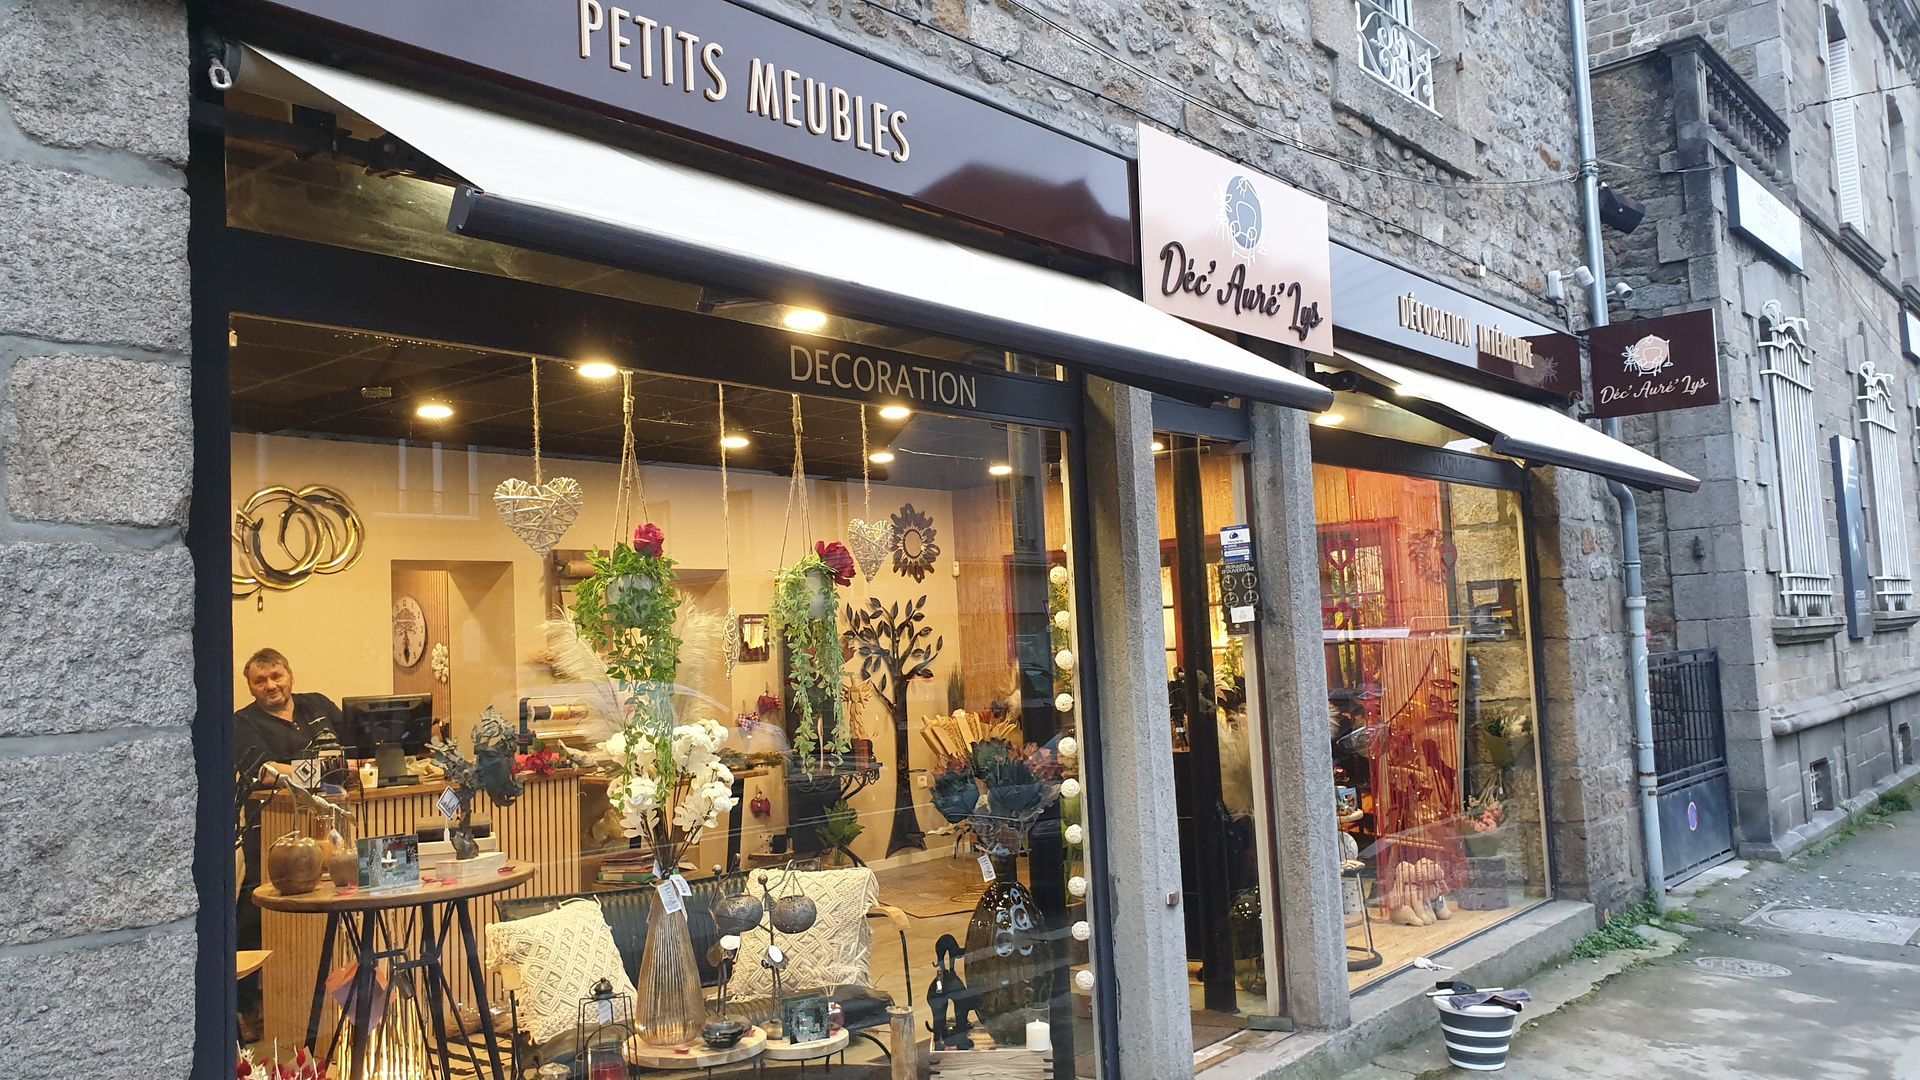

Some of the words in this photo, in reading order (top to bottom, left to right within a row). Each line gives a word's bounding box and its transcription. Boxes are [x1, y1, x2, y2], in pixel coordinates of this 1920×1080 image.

[577, 0, 728, 102] PETITS
[748, 57, 911, 163] MEUBLES
[1398, 291, 1472, 347] DÉCORATION
[1475, 324, 1535, 369] INTÉRIEURE
[790, 345, 977, 408] DECORATION
